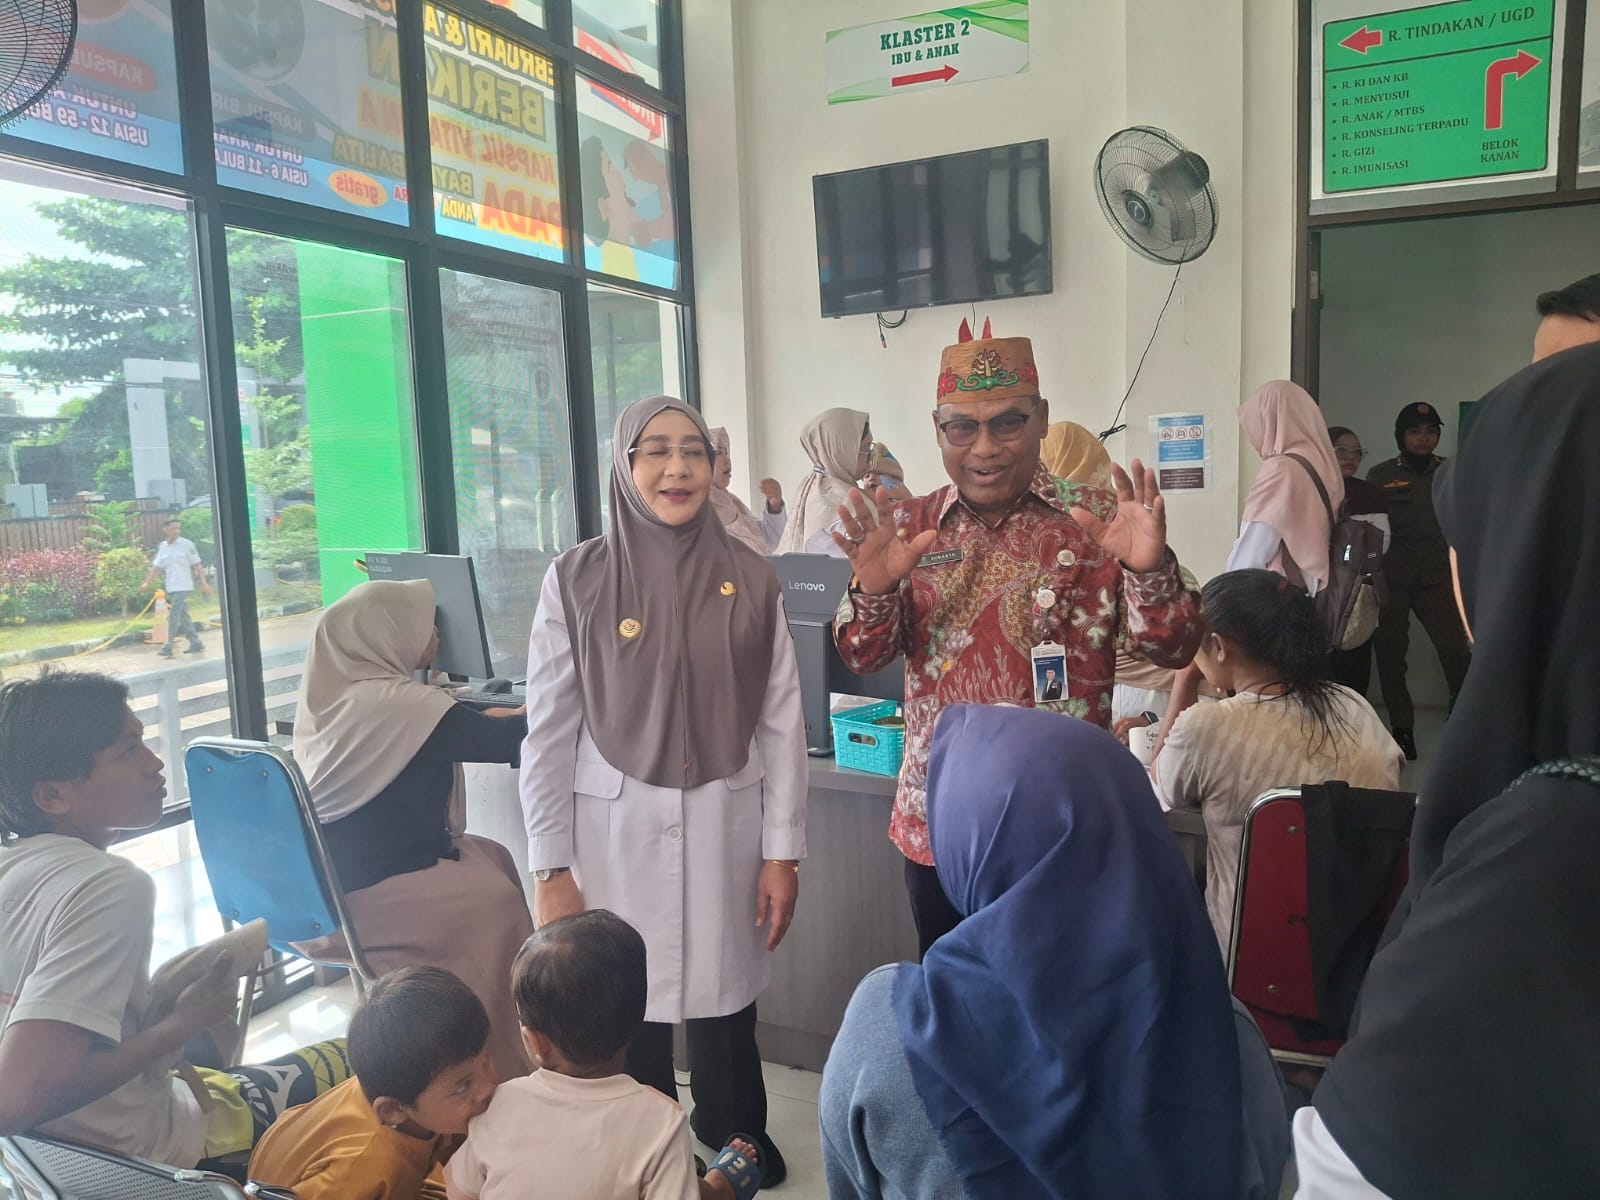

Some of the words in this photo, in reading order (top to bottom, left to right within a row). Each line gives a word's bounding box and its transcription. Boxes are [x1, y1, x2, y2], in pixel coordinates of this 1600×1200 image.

[1388, 30, 1401, 42] R.
[1405, 15, 1484, 40] TINDAKAN
[1501, 6, 1535, 25] UGD
[880, 22, 955, 51] KLASTER
[961, 19, 970, 37] 2
[891, 52, 911, 65] IBU
[915, 49, 923, 61] &
[926, 43, 960, 59] ANAK
[1341, 80, 1351, 89] R.
[1354, 78, 1366, 88] KI
[1368, 75, 1391, 87] DAN
[1393, 73, 1409, 84] KB
[1341, 98, 1351, 107] R.
[1354, 90, 1410, 106] MENYUSUI
[1341, 115, 1351, 125] R.
[1354, 110, 1384, 123] ANAK
[1394, 105, 1425, 118] MTBS
[1341, 132, 1351, 142] R.
[1354, 125, 1414, 140] KONSELING
[1416, 117, 1469, 132] TERPADU
[1341, 149, 1351, 158] R.
[1354, 146, 1375, 157] GIZI
[1482, 138, 1519, 151] BELOK
[1480, 150, 1520, 163] KANAN
[1341, 166, 1351, 176] R.
[1354, 160, 1409, 174] IMUNISASI
[788, 580, 826, 592] Lenovo
